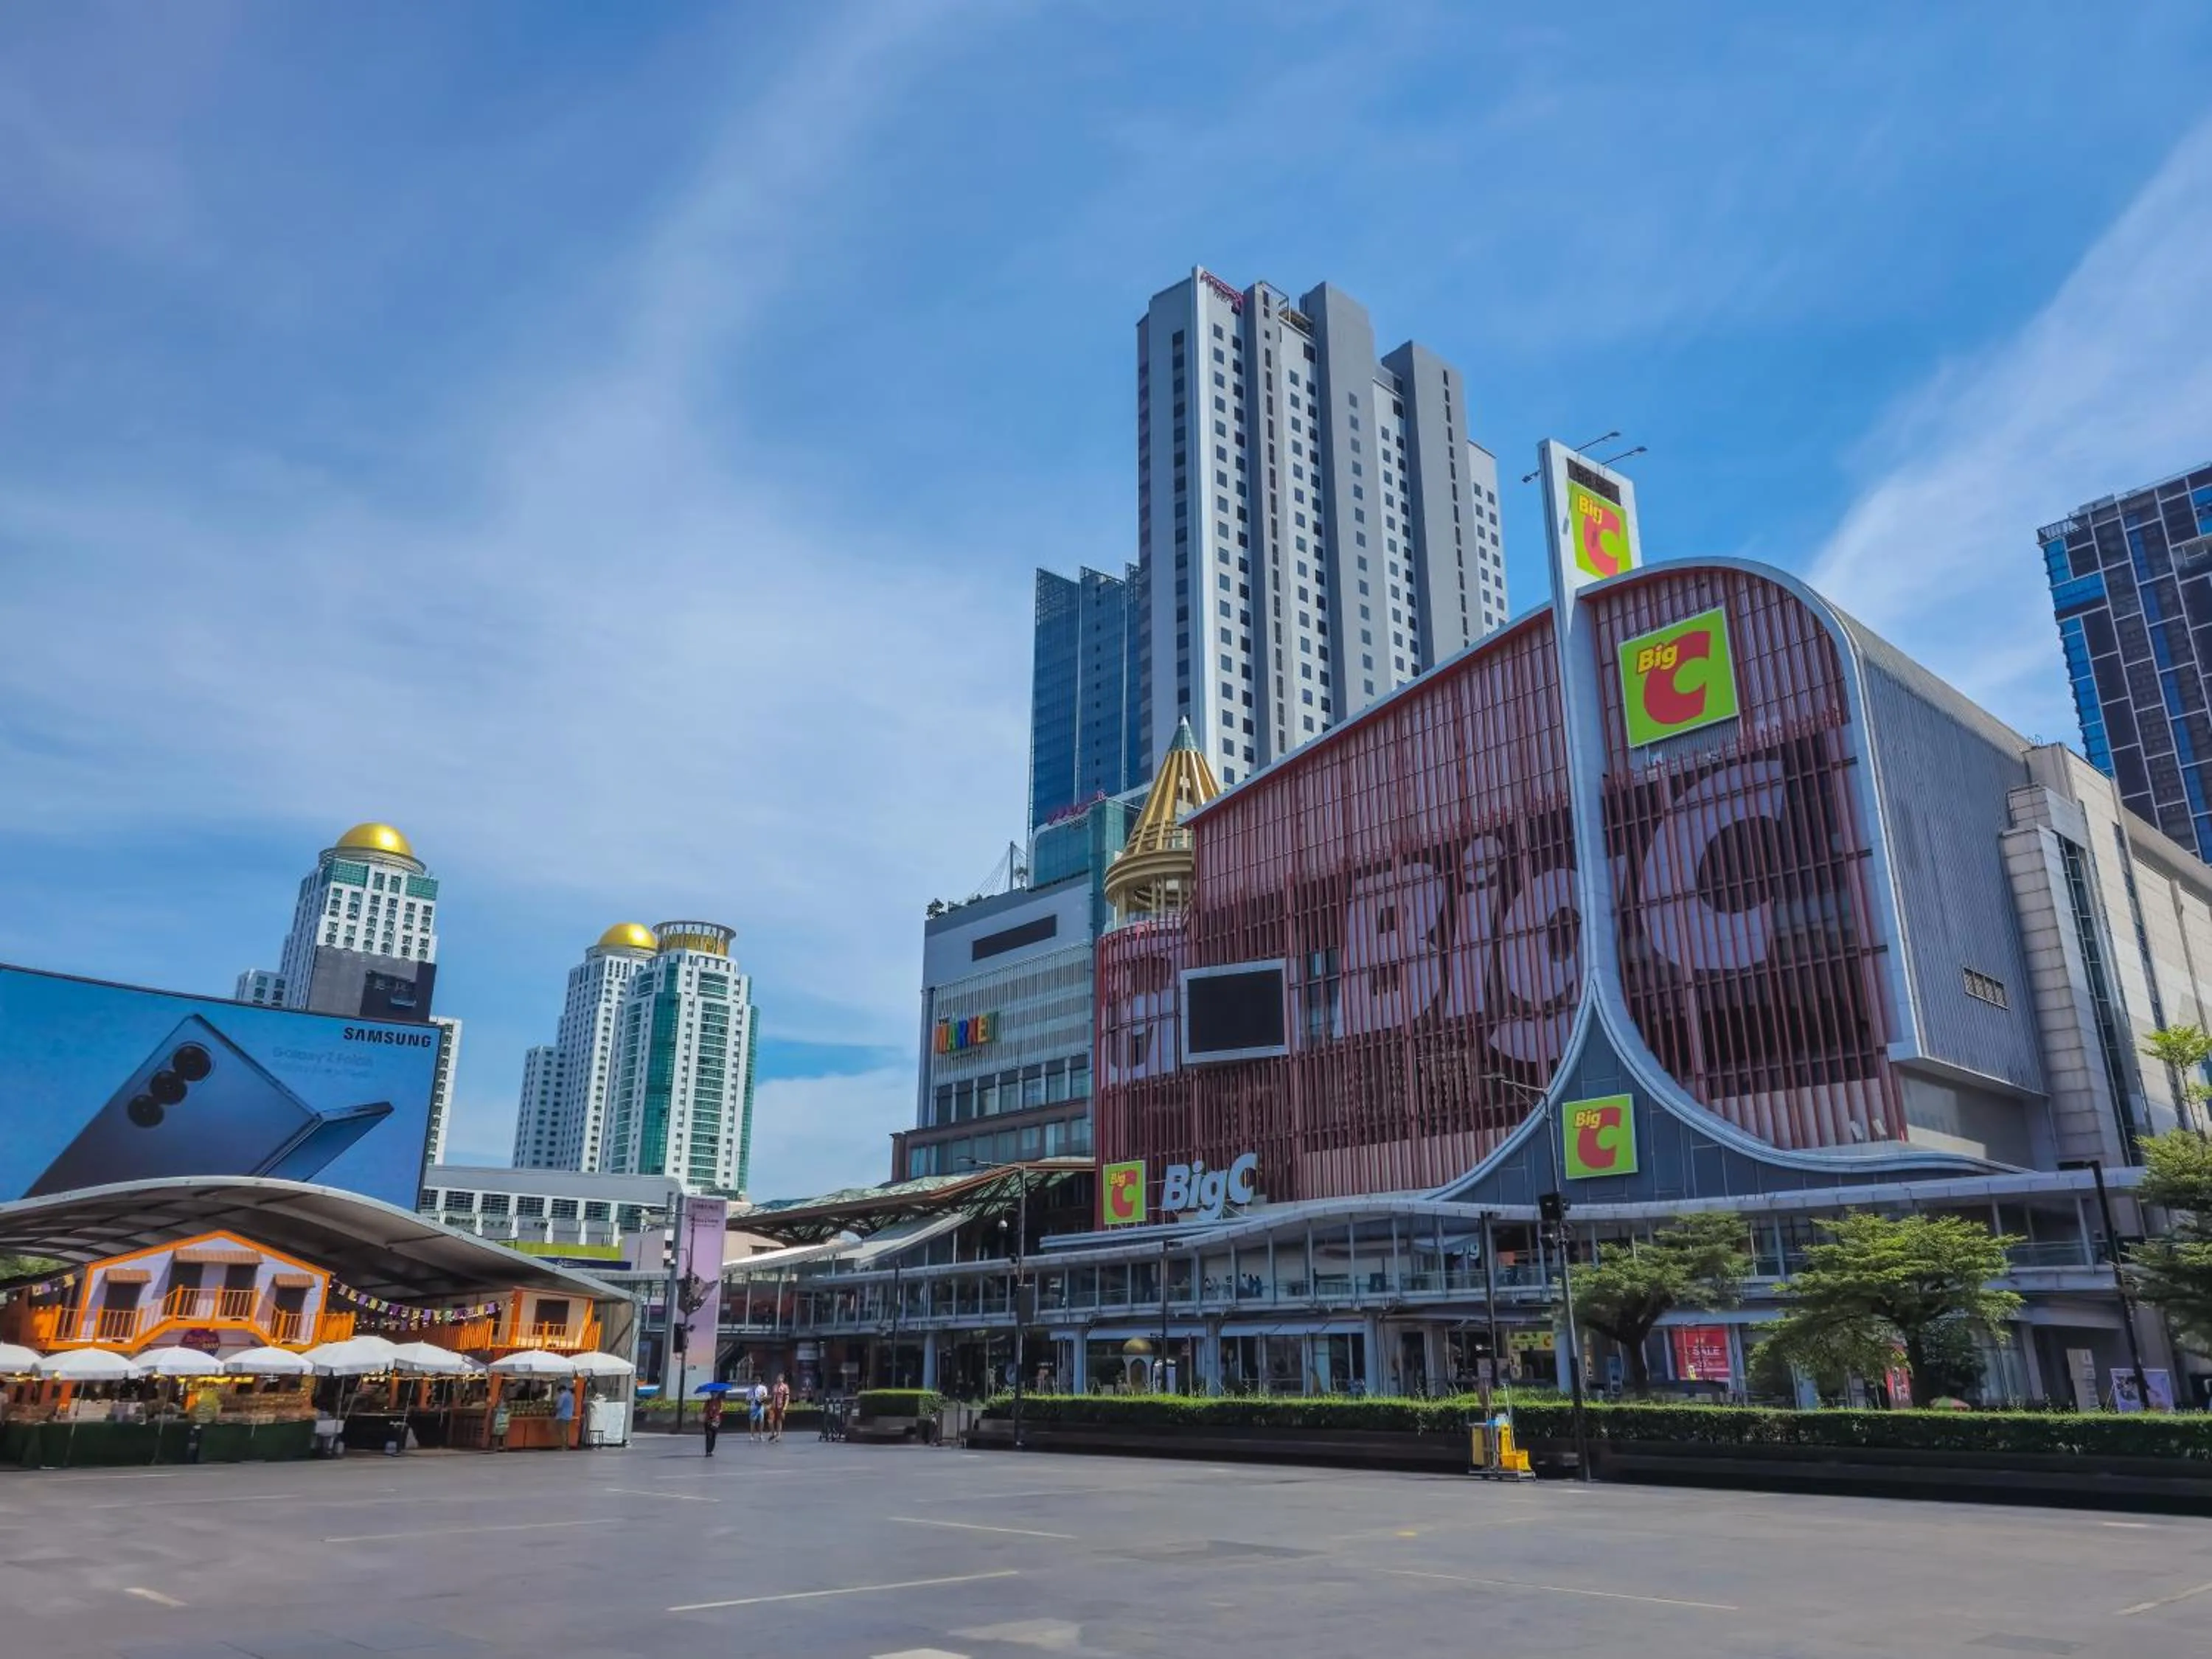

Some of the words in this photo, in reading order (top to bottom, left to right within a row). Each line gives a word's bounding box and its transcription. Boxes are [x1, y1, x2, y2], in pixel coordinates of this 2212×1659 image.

[1578, 495, 1603, 526] Big
[1636, 642, 1679, 674] Big
[1643, 630, 1711, 725] C
[344, 1027, 431, 1048] SAMSUNG
[934, 1011, 999, 1055] MARKET
[1573, 1109, 1601, 1129] Big
[1577, 1106, 1621, 1169] C
[1109, 1171, 1127, 1187] Big
[1111, 1169, 1138, 1217] C
[1691, 1346, 1721, 1356] SALE
